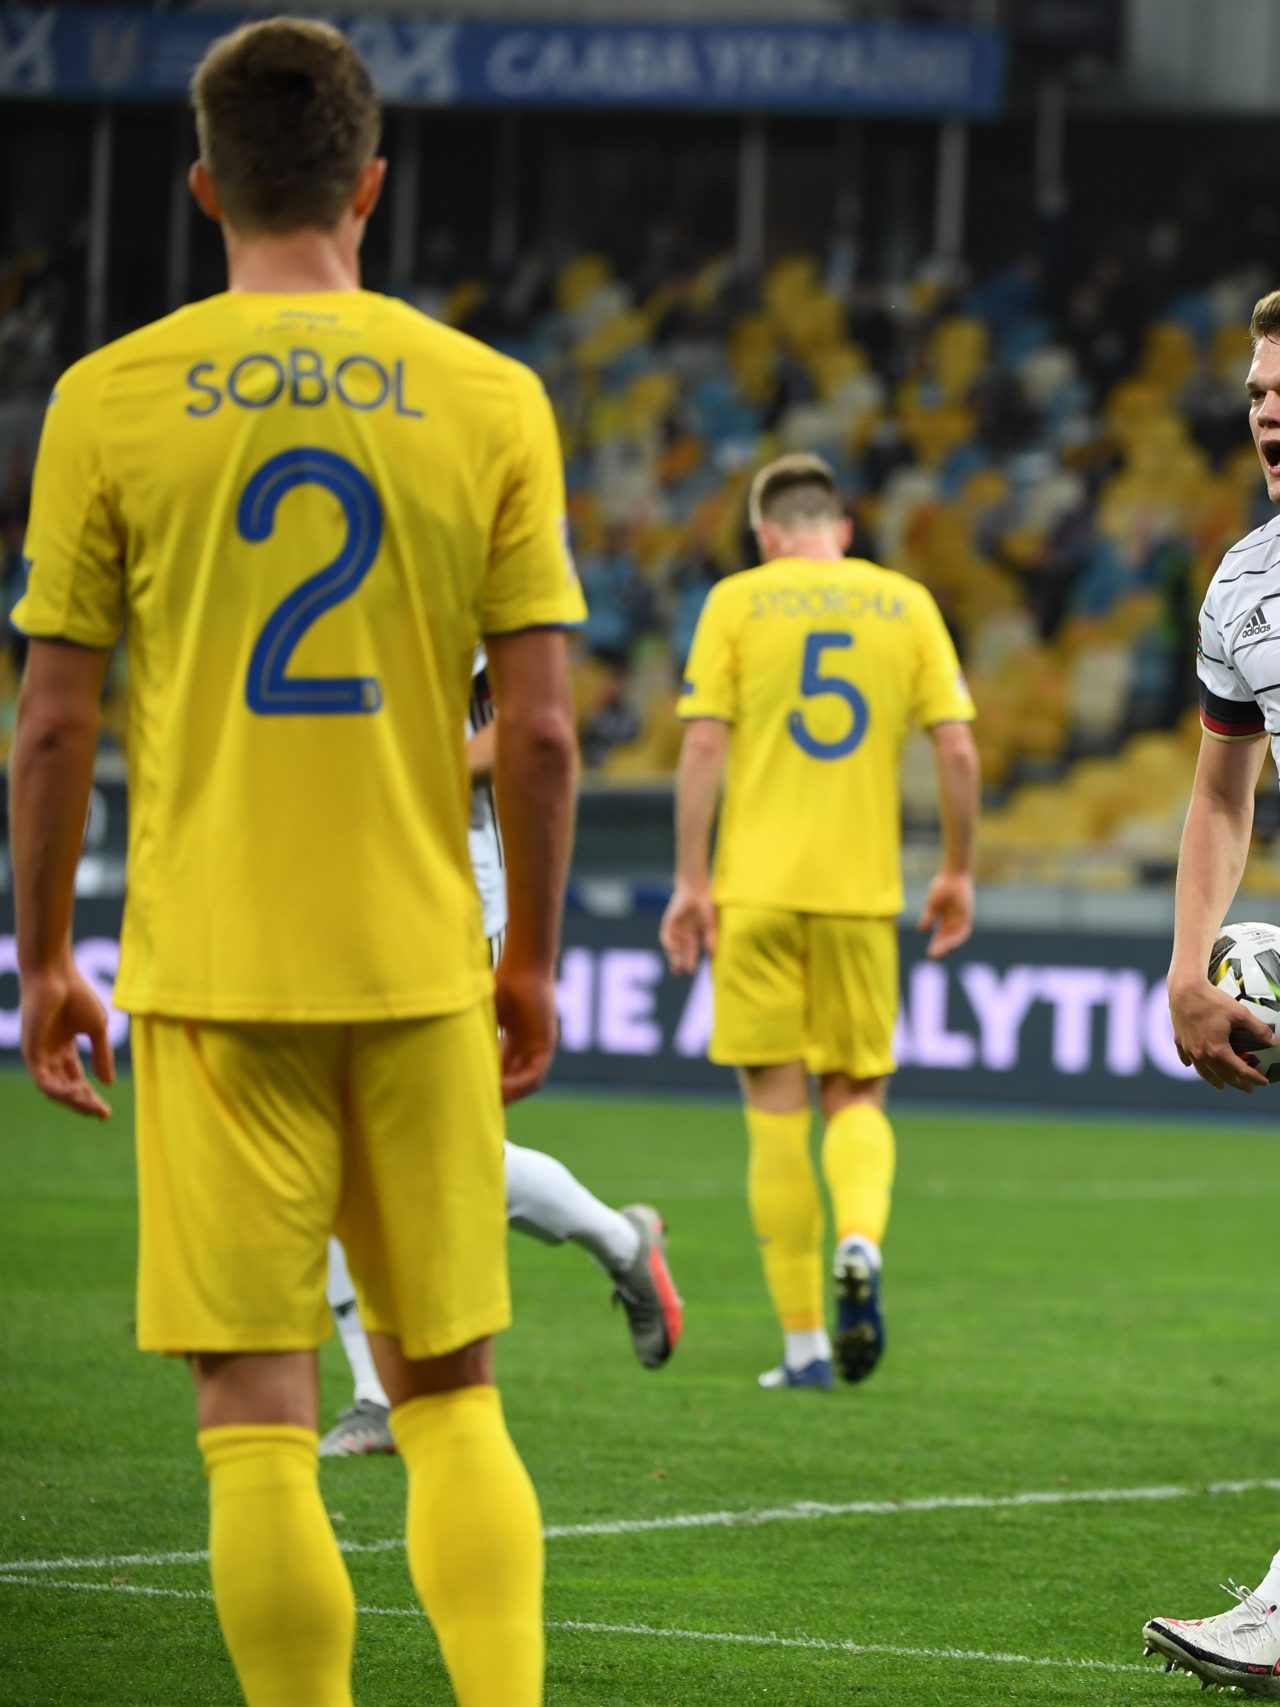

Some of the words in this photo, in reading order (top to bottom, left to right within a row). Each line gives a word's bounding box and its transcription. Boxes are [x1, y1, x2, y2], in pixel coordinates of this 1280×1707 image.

[185, 347, 424, 418] SOBOL
[236, 446, 384, 716] 2
[1242, 623, 1271, 639] adidas
[786, 631, 869, 760] 5
